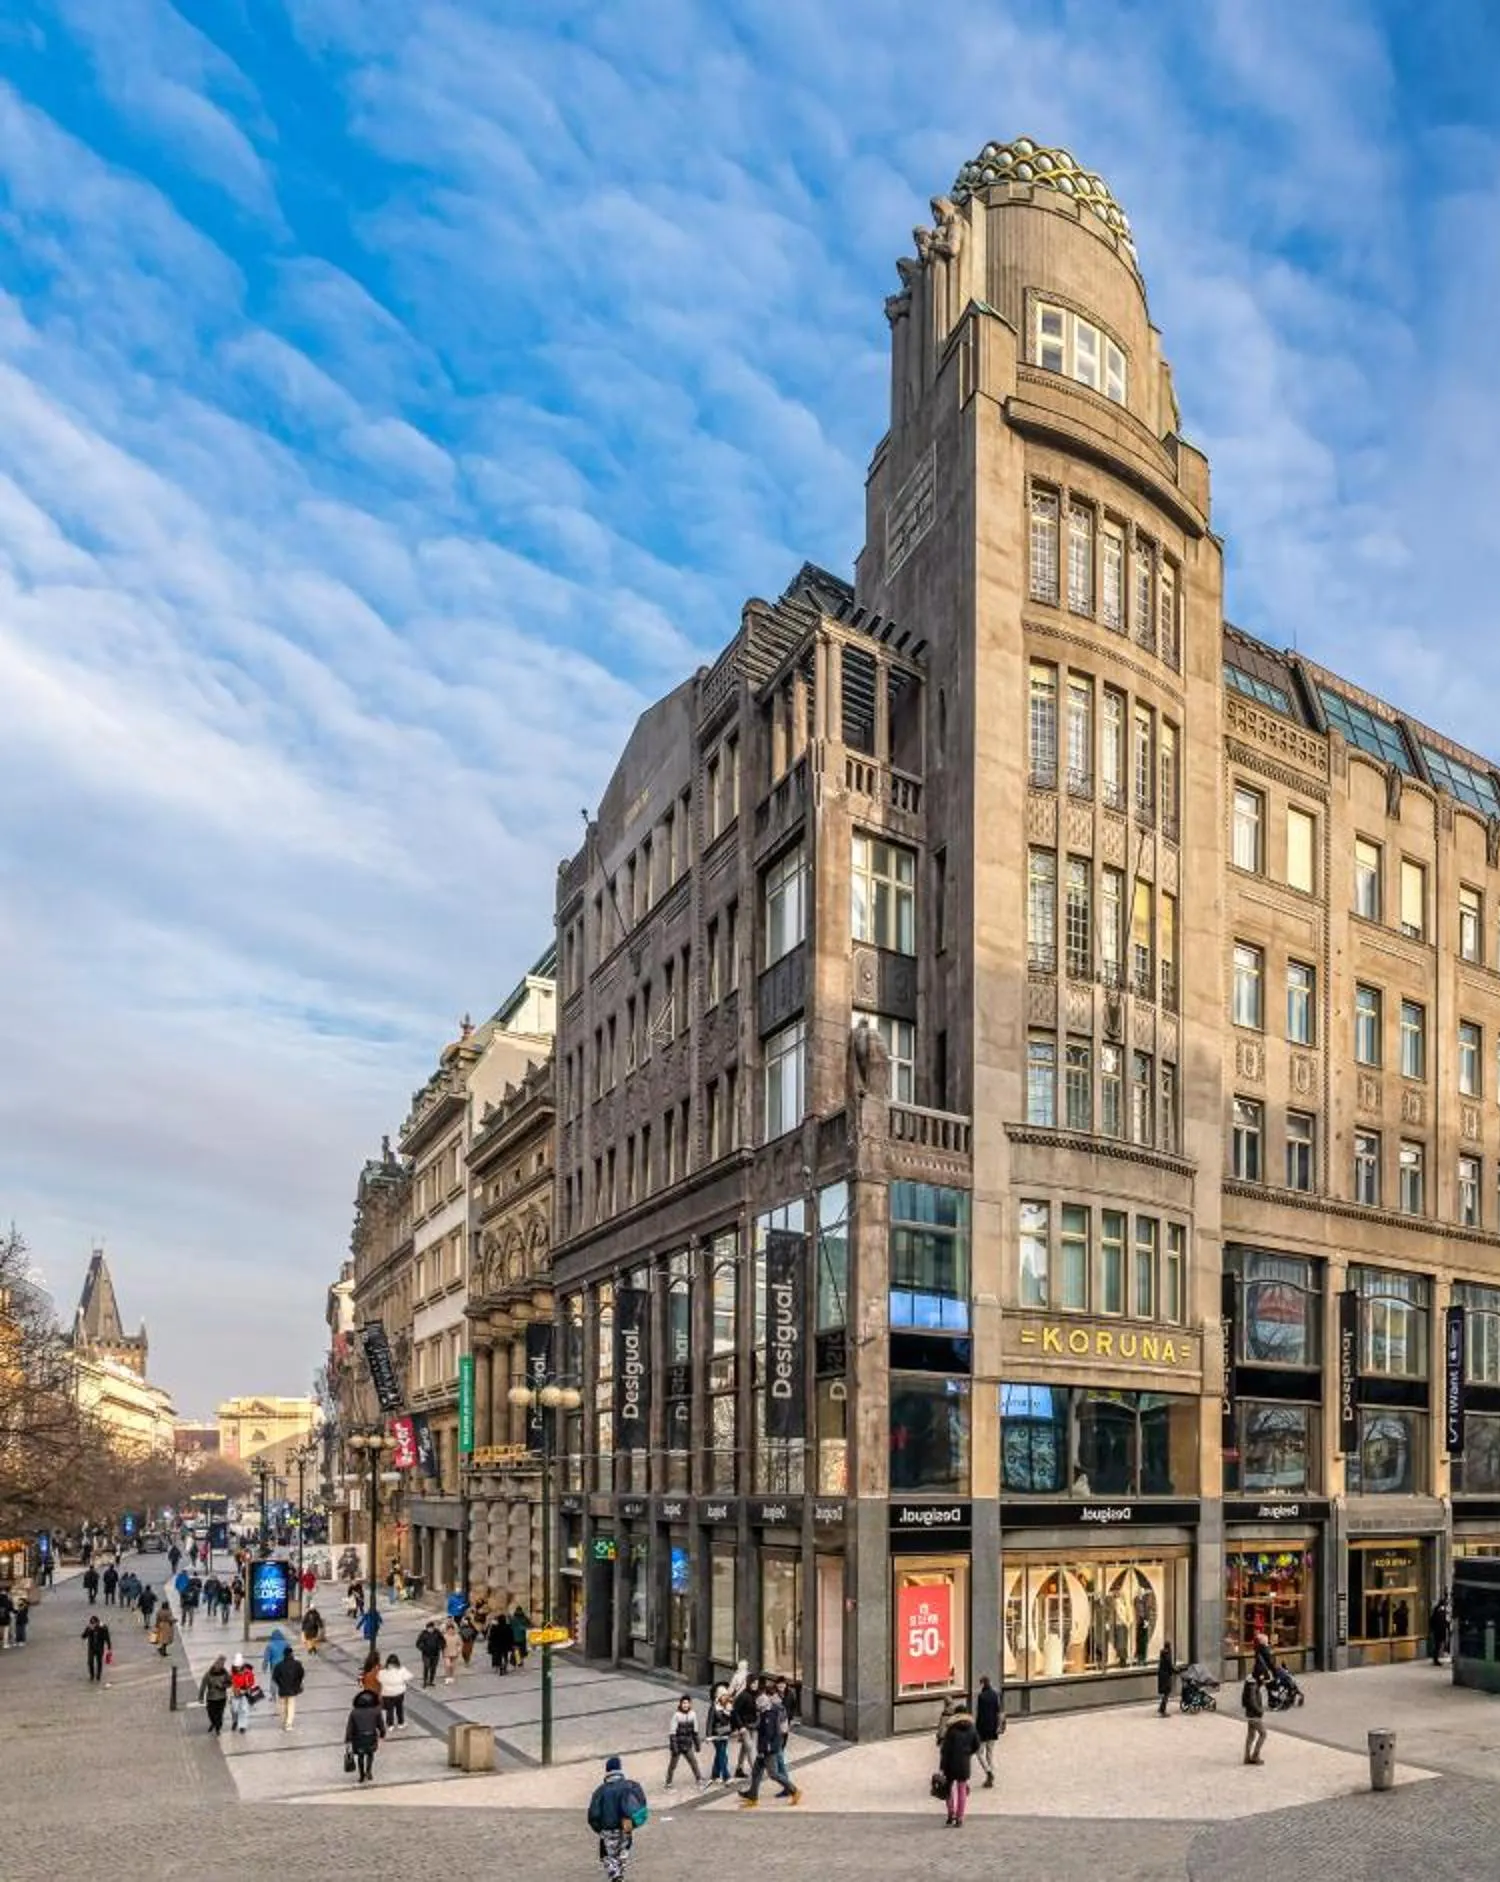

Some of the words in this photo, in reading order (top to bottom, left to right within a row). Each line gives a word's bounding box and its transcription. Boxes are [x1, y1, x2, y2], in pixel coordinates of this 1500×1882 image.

[621, 1325, 645, 1419] Desigual.
[771, 1279, 798, 1398] Desigual.
[1042, 1327, 1177, 1363] KORUNA
